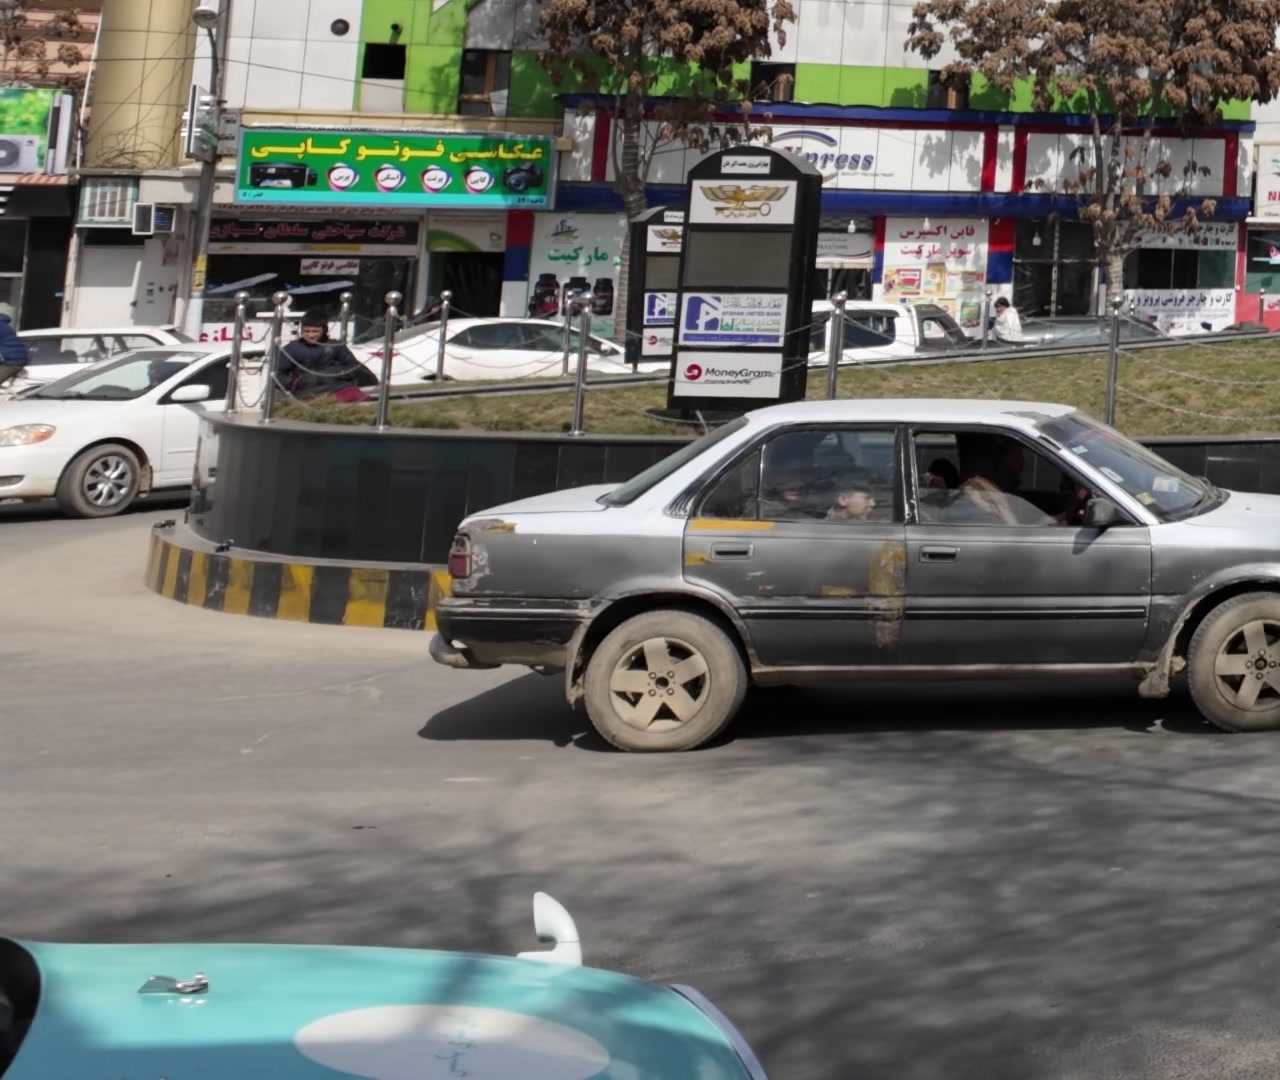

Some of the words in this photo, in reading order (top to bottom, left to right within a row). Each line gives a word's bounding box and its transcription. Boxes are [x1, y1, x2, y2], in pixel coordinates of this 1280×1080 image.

[251, 137, 352, 160] کاپی
[356, 139, 445, 163] فوتو
[450, 143, 543, 164] عکاسی
[704, 367, 771, 379] MoneyGram
